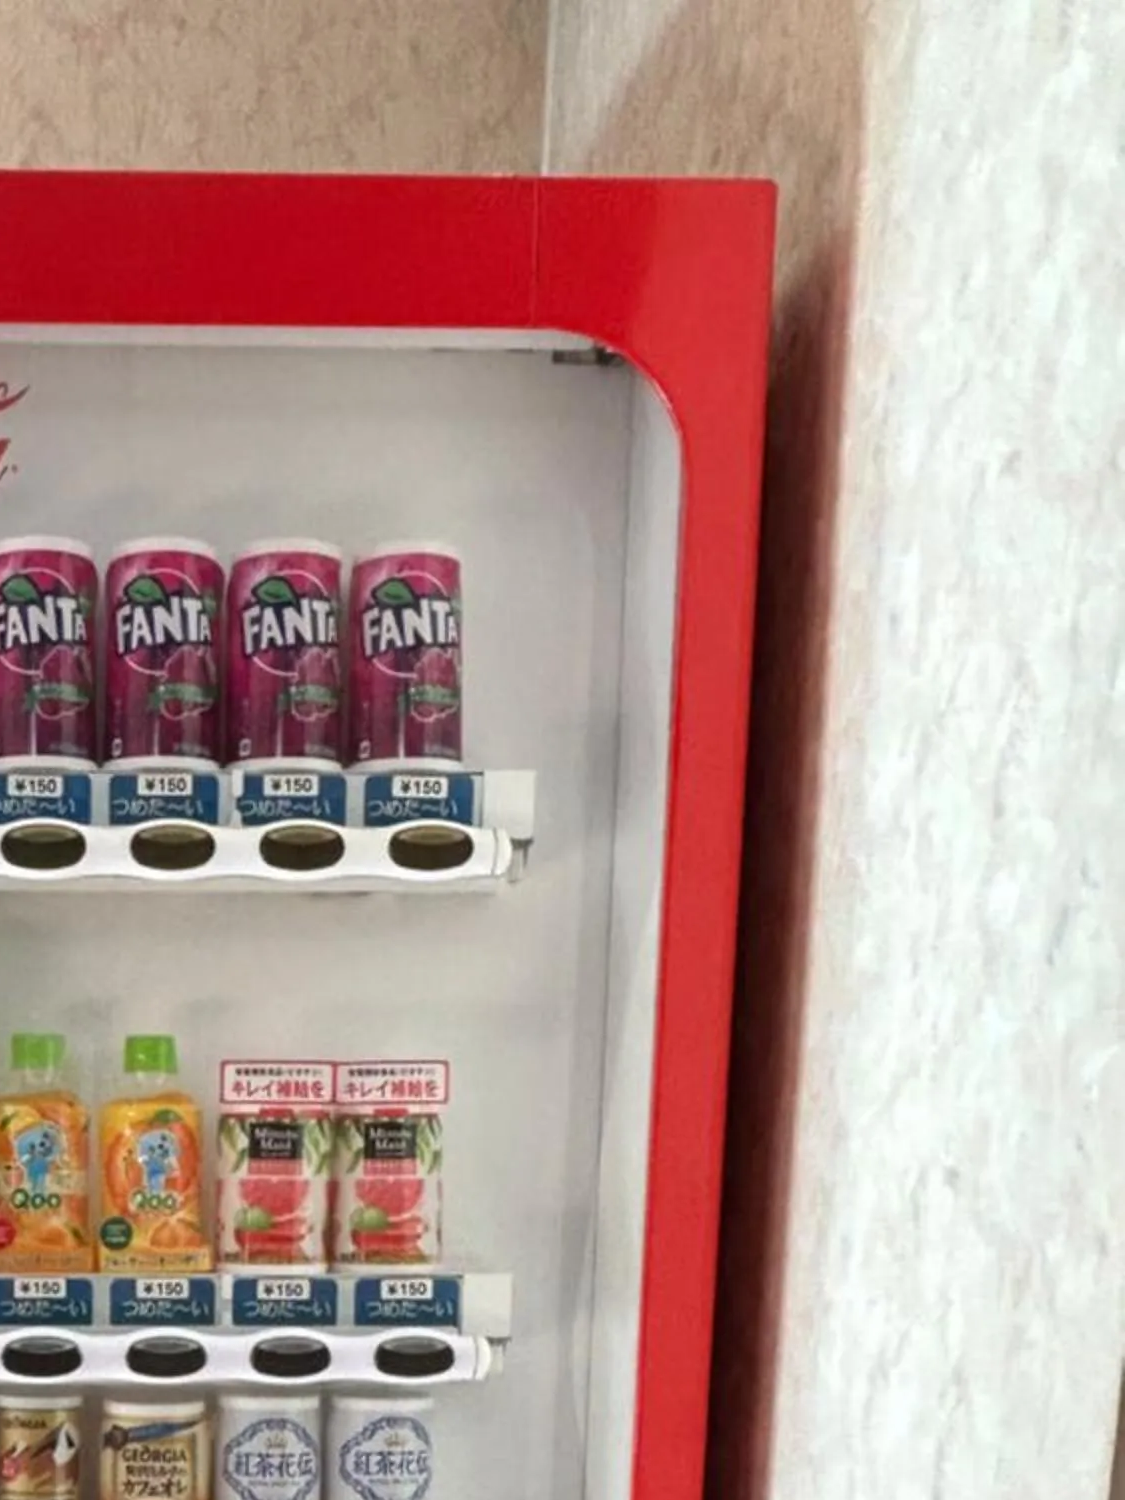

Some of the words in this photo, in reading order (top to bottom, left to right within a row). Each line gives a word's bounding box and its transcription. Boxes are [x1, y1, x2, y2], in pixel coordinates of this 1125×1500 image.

[116, 596, 210, 655] FANTA
[242, 597, 337, 656] FANTA
[362, 598, 458, 657] FANTA
[12, 1188, 61, 1209] Qoo
